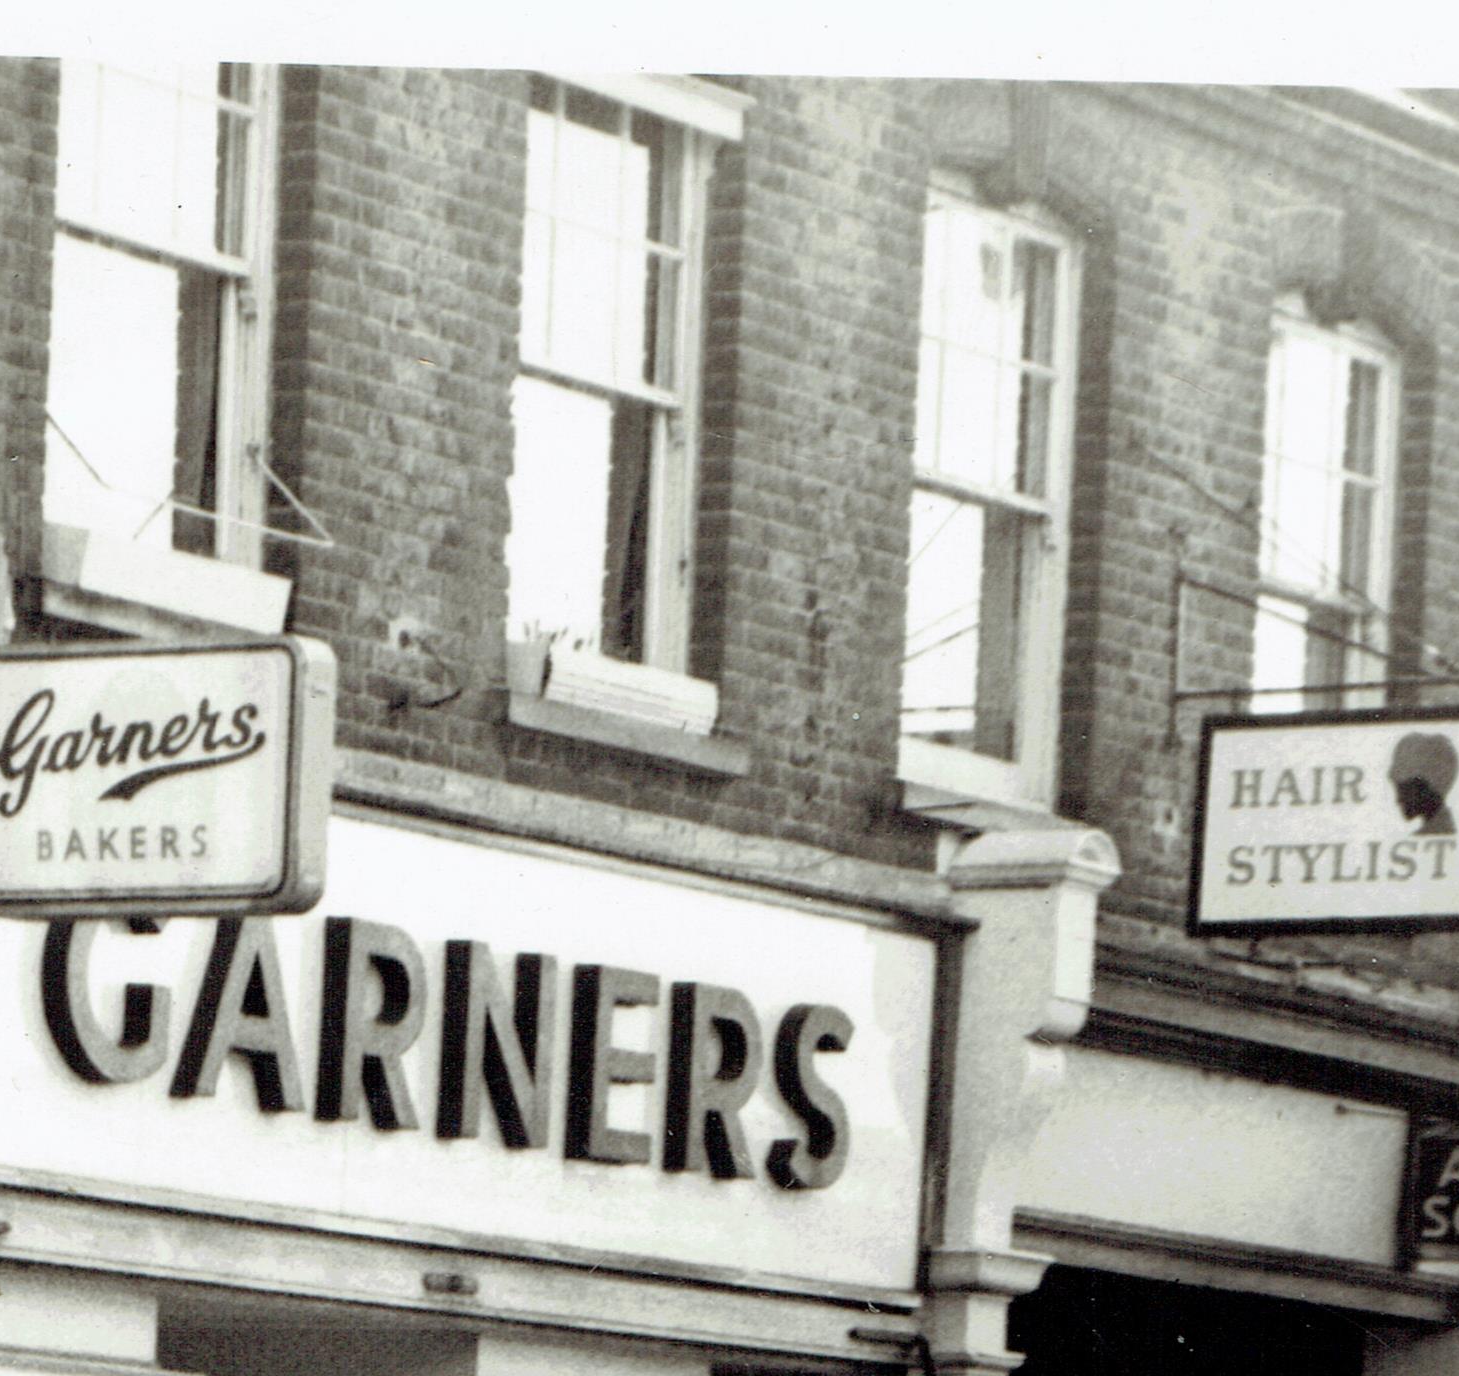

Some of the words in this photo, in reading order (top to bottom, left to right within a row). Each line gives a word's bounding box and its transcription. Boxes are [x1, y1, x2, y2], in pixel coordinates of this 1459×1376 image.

[1227, 765, 1369, 809] HAIR
[35, 822, 211, 865] BAKERS
[1224, 838, 1458, 887] STYLIST
[39, 915, 857, 1192] GARNERS
